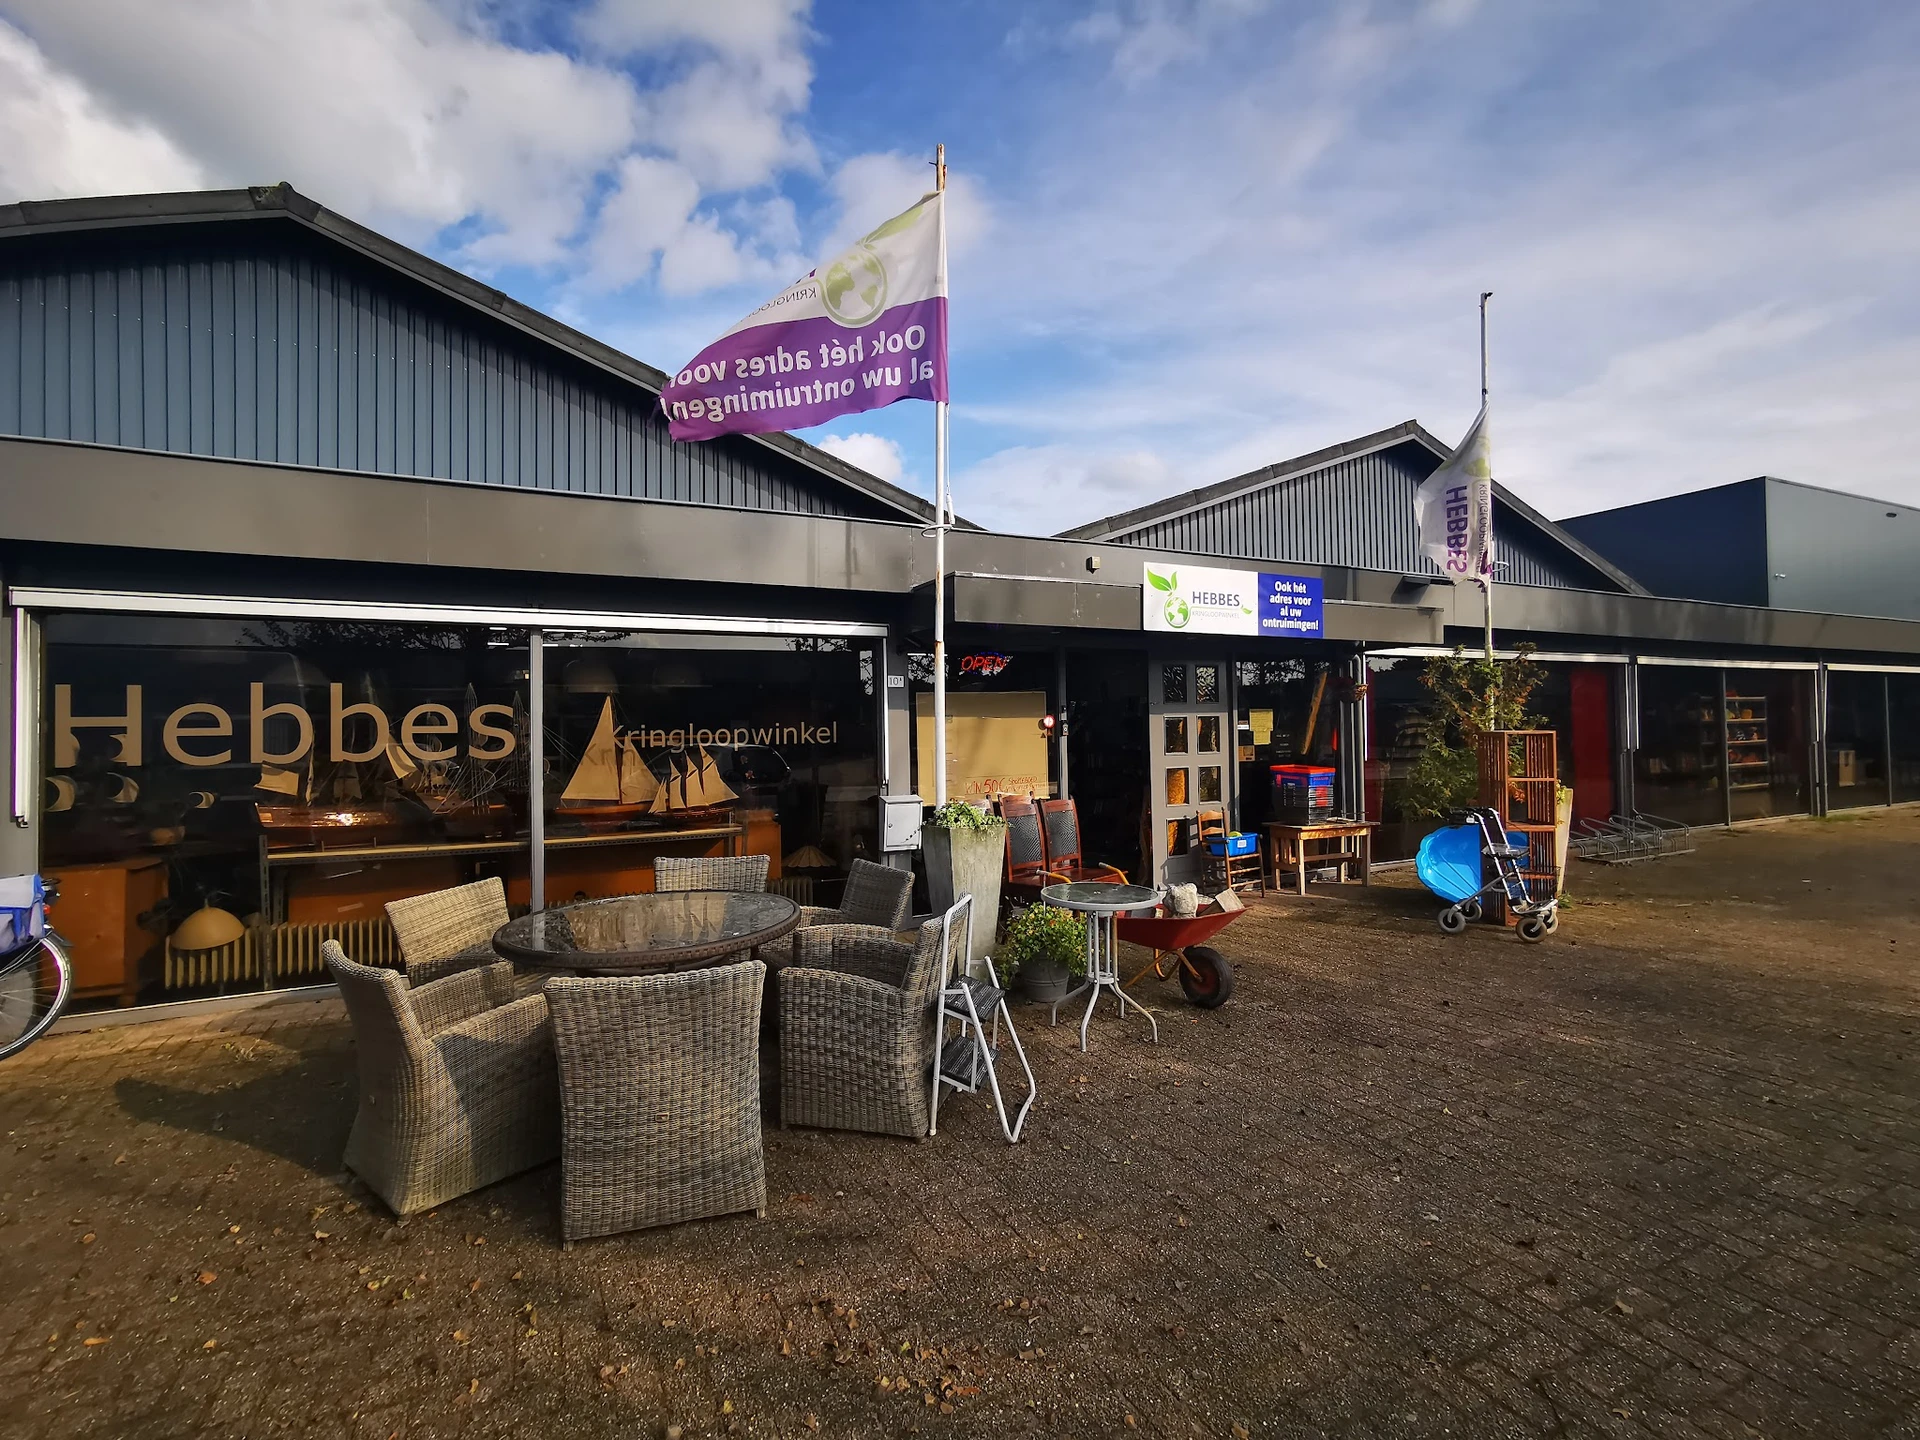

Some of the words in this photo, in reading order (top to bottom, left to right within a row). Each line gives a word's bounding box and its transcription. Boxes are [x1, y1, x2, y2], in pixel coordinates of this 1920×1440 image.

[1274, 581, 1292, 592] Ook
[1293, 582, 1307, 594] hét
[1192, 591, 1240, 607] HEBBES
[1269, 593, 1292, 604] adres
[1293, 596, 1312, 606] voor
[1280, 606, 1289, 616] al
[1289, 608, 1302, 617] uw
[1262, 617, 1319, 632] ontruimingen!
[961, 655, 1007, 671] OPEN
[54, 681, 516, 768] Hebbes
[612, 720, 838, 754] Kringloopwinkel
